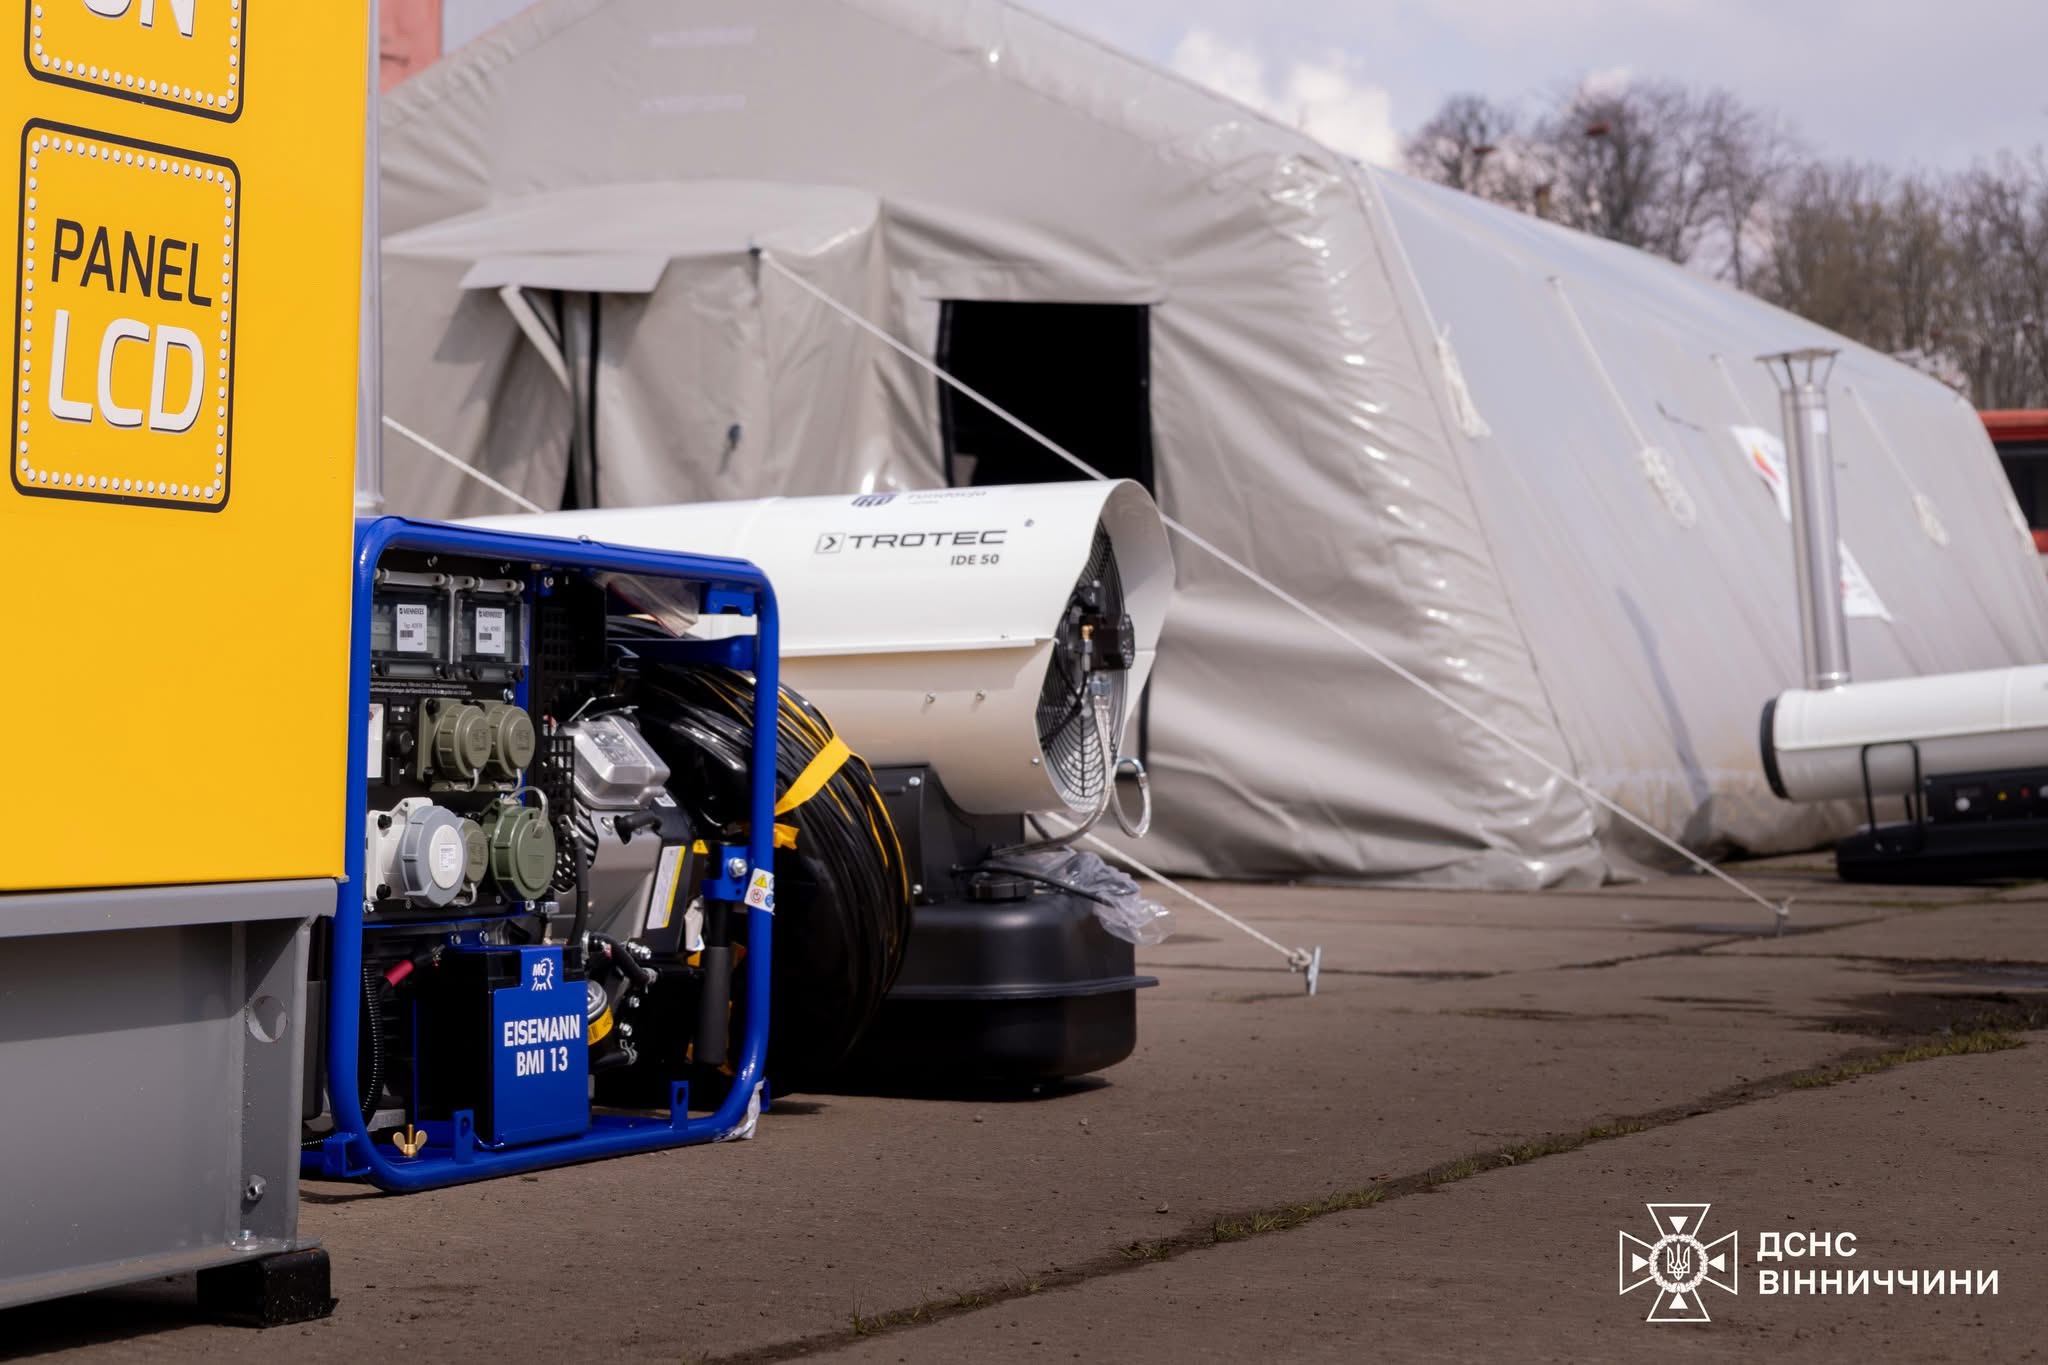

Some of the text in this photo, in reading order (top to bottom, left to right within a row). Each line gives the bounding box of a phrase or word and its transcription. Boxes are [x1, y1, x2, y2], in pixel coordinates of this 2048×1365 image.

[51, 218, 212, 307] PANEL
[48, 309, 206, 433] LCD
[849, 530, 1008, 549] TROTEC
[950, 553, 1000, 566] IDE 50
[532, 962, 547, 977] MG
[504, 1014, 580, 1047] EISEMANN
[516, 1046, 568, 1077] BMI 13
